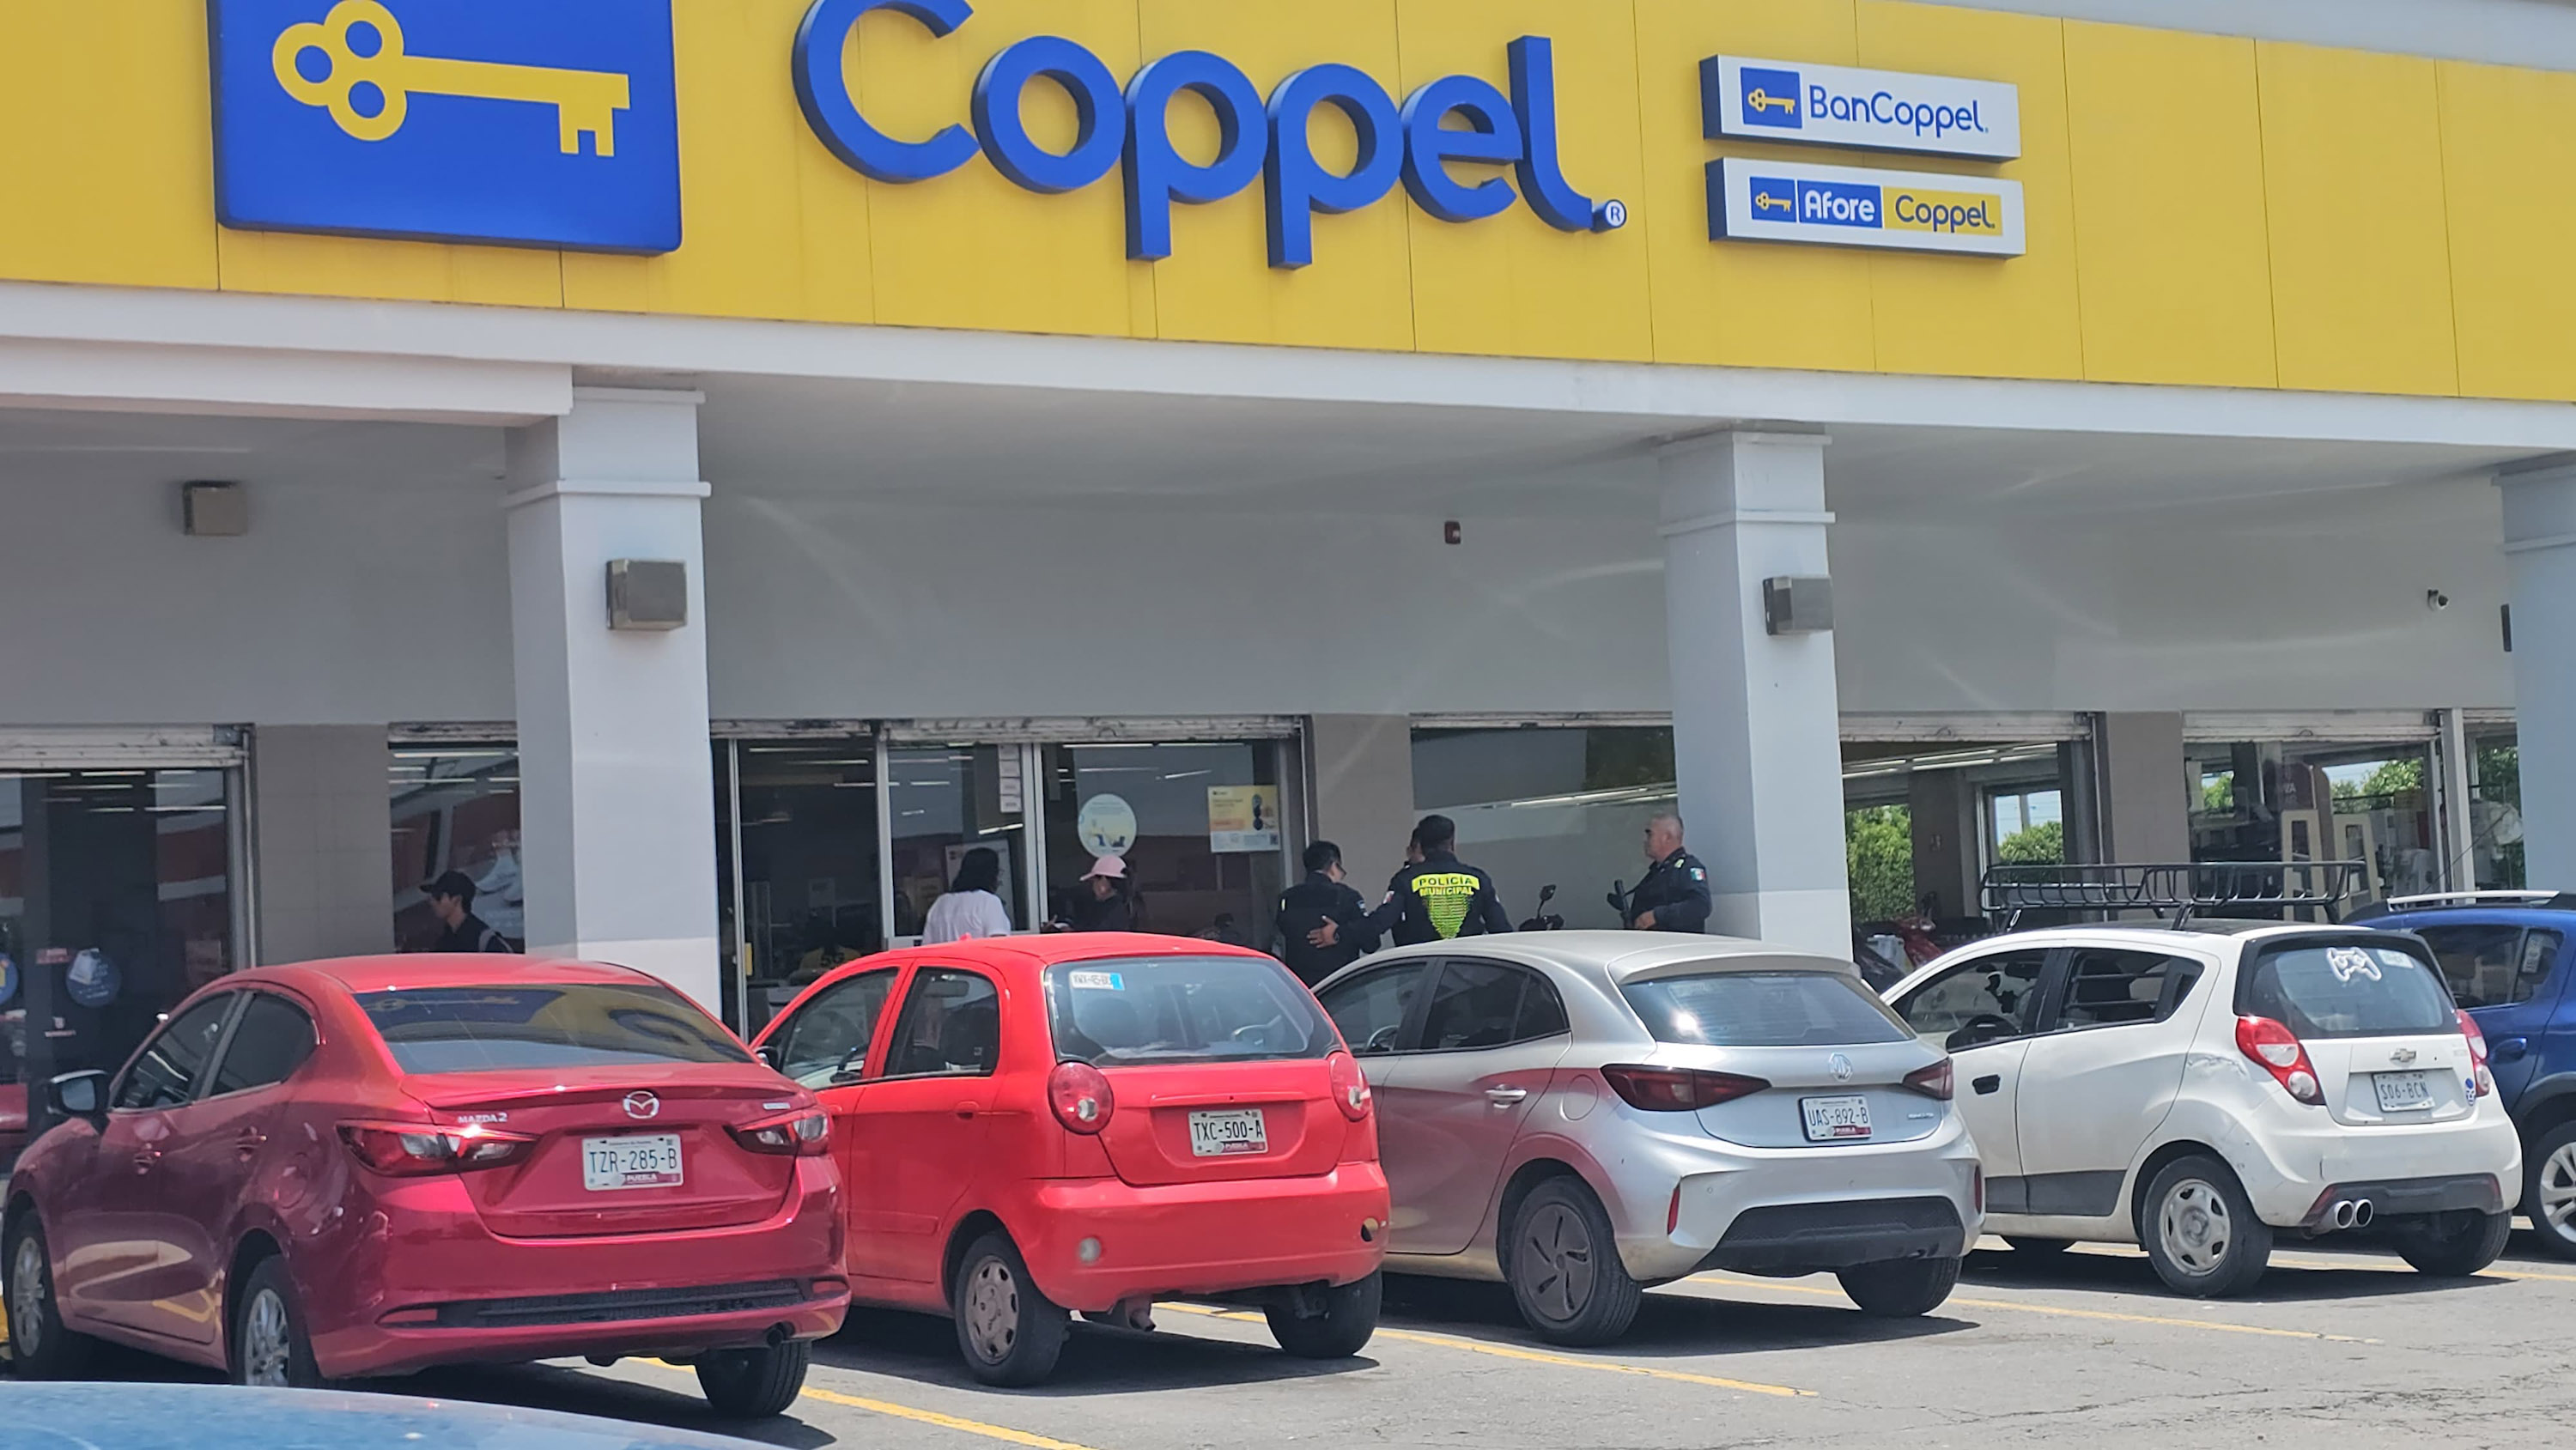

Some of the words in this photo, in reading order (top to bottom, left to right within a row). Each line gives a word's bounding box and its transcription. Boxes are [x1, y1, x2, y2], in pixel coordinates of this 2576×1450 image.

[1808, 83, 1984, 138] BanCoppel
[791, 0, 1592, 270] Coppel
[1804, 189, 1875, 222] Afore
[1894, 194, 1991, 234] Coppel
[1419, 887, 1474, 896] MUNICIPAL
[1807, 1107, 1869, 1127] UAS-892-B
[1193, 1119, 1264, 1142] TXC-500-A
[588, 1148, 677, 1174] TZR-285-B
